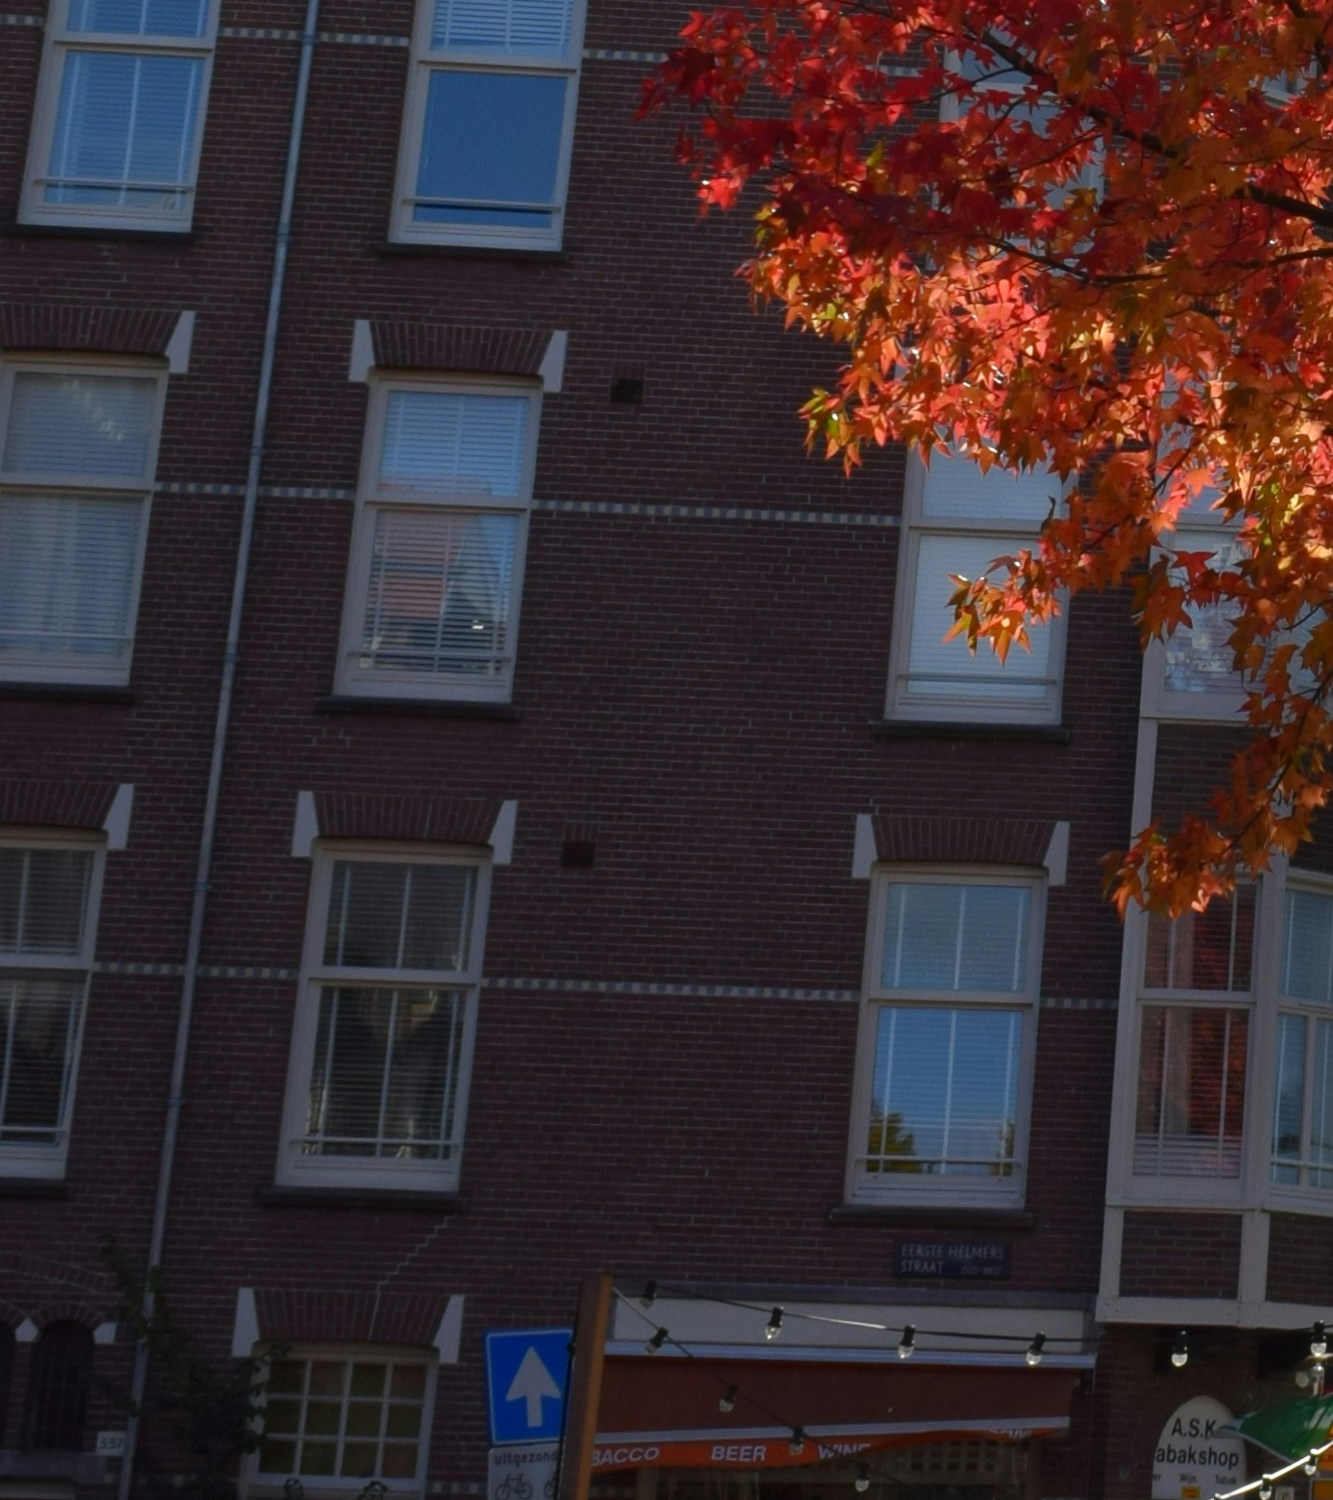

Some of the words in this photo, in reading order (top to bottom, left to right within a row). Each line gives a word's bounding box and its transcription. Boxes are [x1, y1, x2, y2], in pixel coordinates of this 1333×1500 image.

[901, 1243, 944, 1258] EERSTE
[948, 1244, 1005, 1260] HELMERS
[901, 1260, 945, 1273] STRAAT
[493, 1450, 560, 1468] uitgezond
[591, 1446, 661, 1467] BACCO
[710, 1445, 768, 1463] BEER
[1155, 1443, 1240, 1470] abakshop
